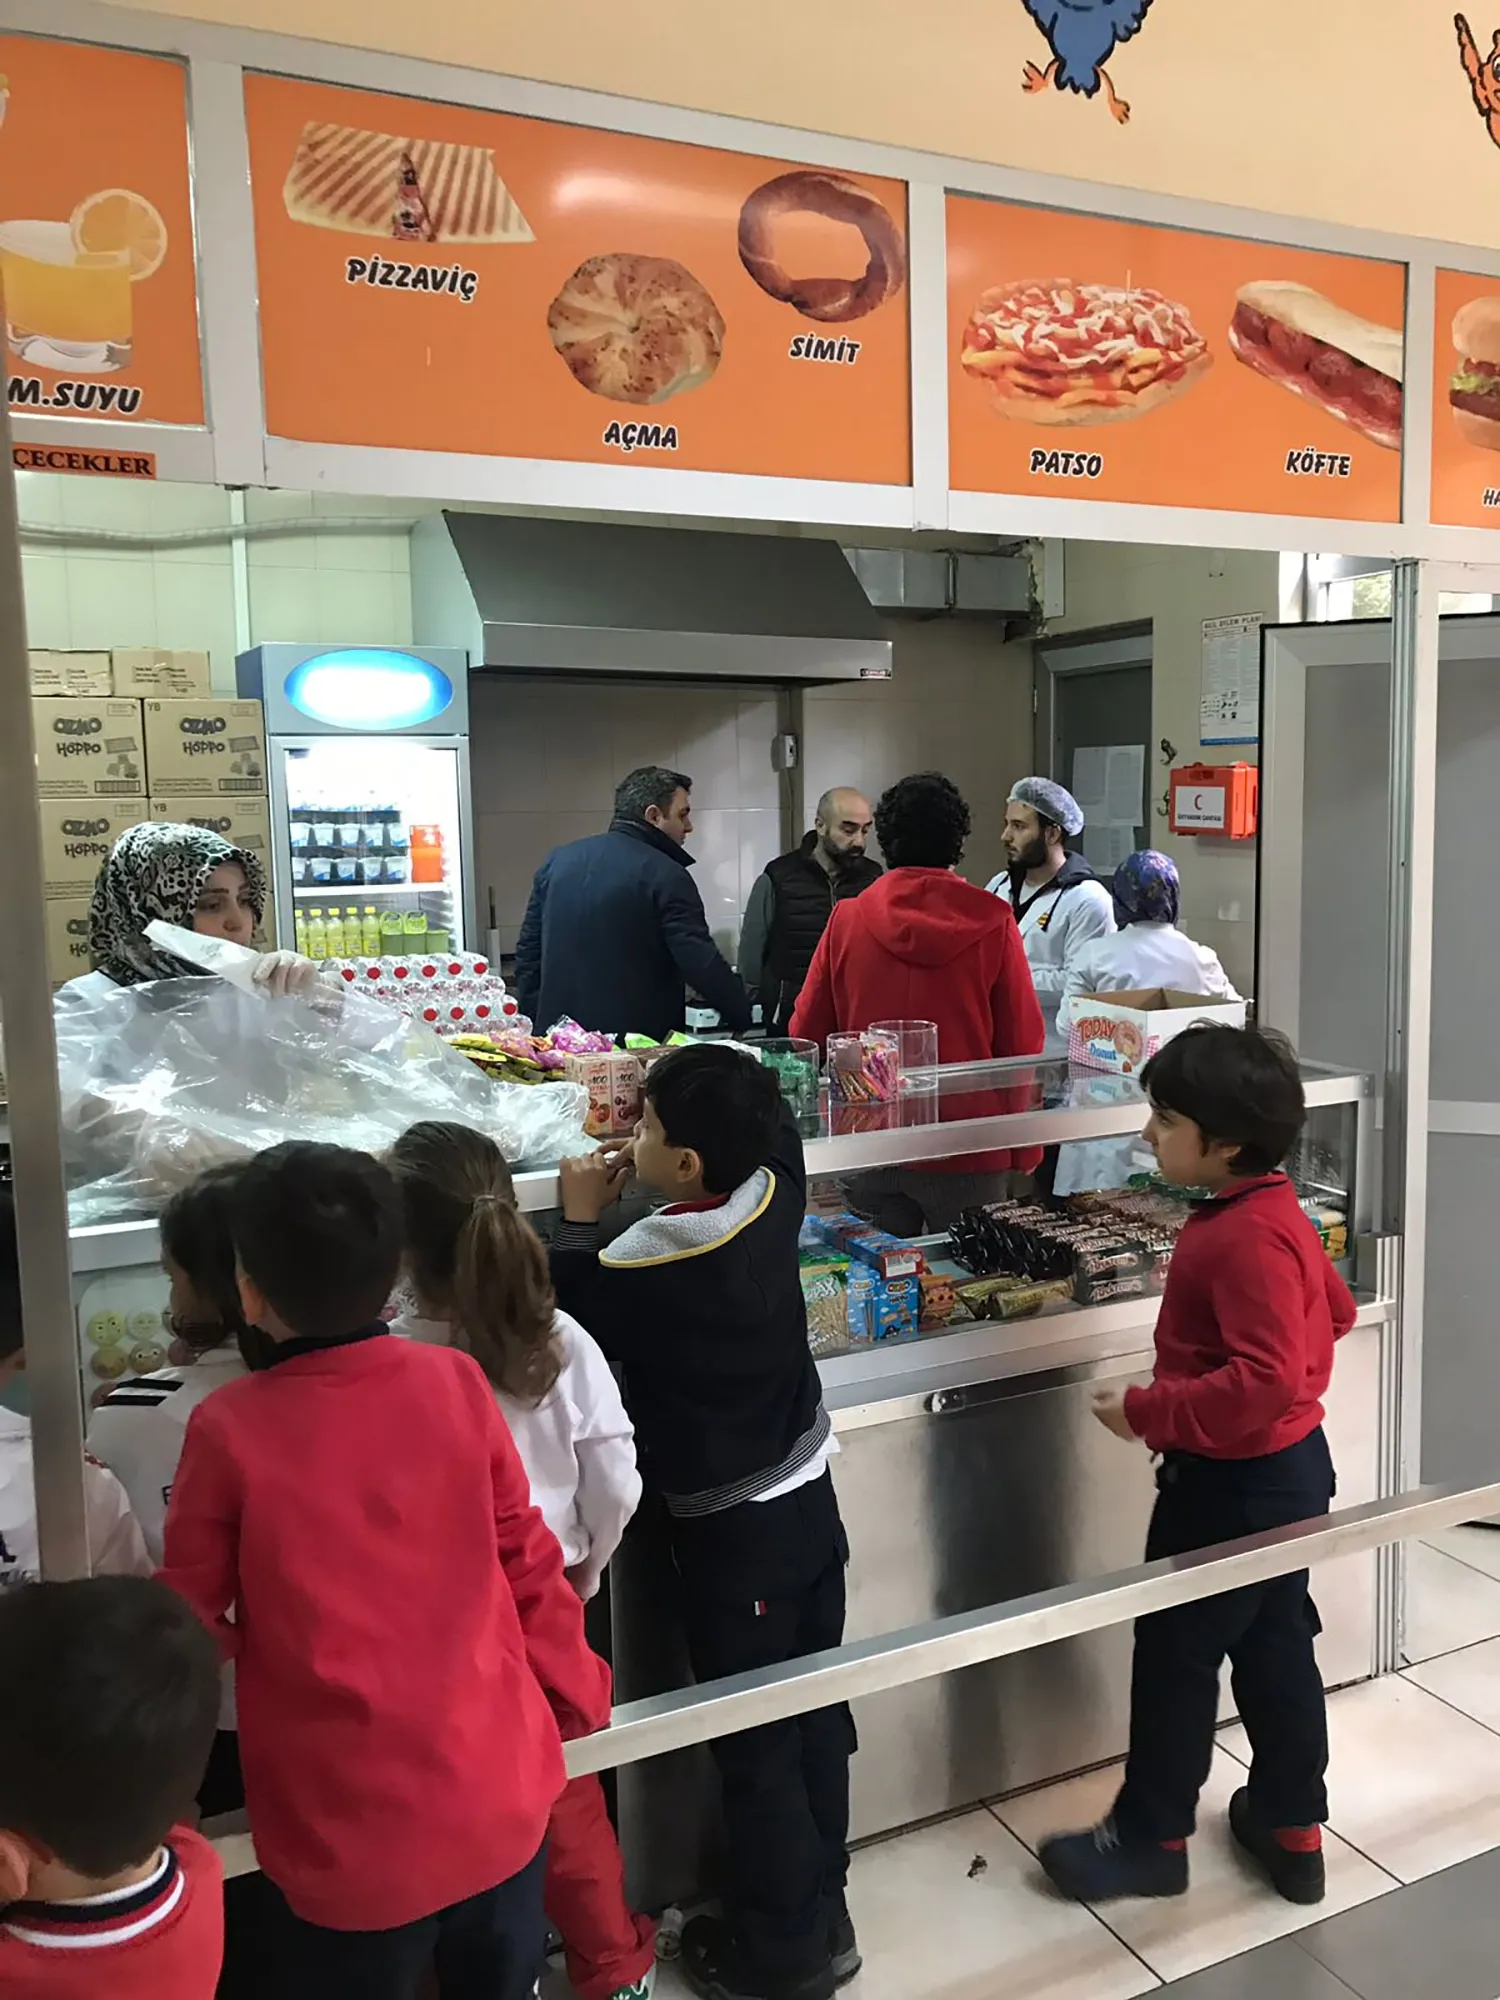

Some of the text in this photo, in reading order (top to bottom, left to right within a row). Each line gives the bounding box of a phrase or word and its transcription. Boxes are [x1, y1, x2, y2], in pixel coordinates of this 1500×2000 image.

[346, 254, 478, 302] PİZZAVİÇ
[789, 332, 861, 363] SİMİT
[603, 421, 678, 451] AÇMA
[13, 447, 153, 476] ÇECEKLER
[1030, 449, 1103, 477] PATSO
[1285, 446, 1351, 476] KÖFTE
[1077, 1017, 1118, 1043] TODAY
